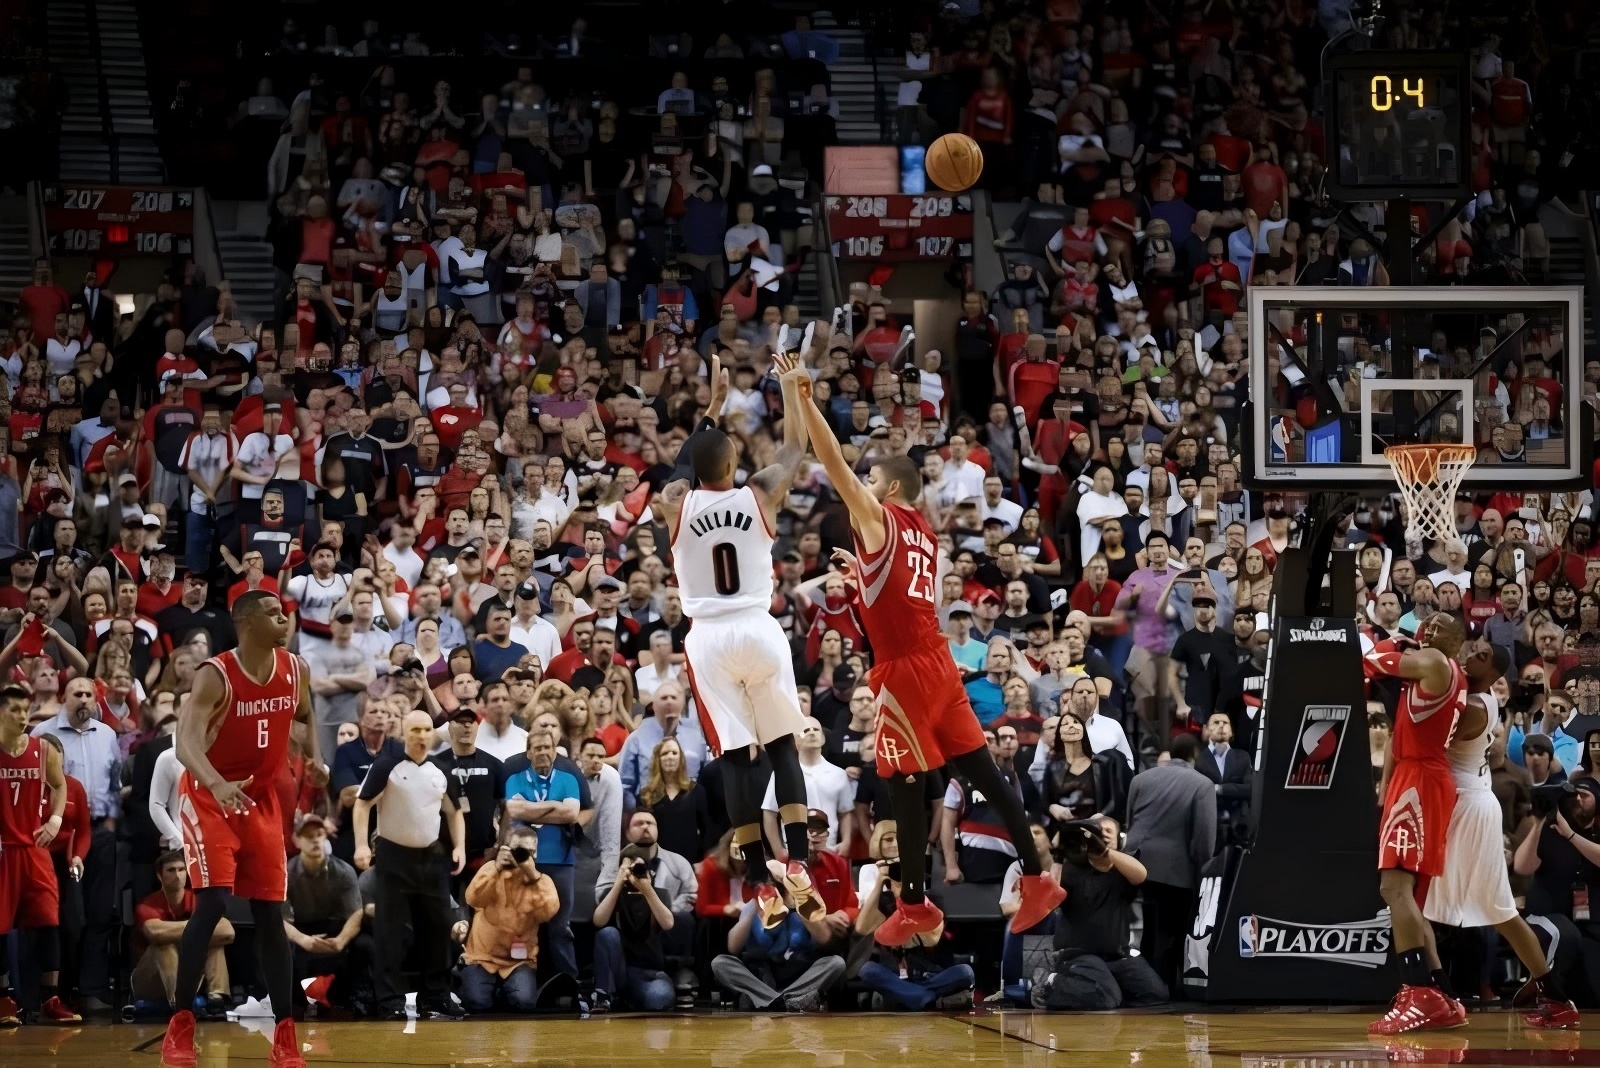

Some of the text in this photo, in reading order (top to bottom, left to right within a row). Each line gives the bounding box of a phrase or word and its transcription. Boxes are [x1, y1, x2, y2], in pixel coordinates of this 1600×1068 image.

[1371, 75, 1424, 111] 0.4
[63, 189, 106, 210] 207
[909, 197, 953, 218] 209
[136, 232, 176, 253] 106
[845, 236, 884, 257] 106
[916, 236, 954, 256] 107
[712, 542, 740, 596] 0
[907, 550, 935, 604] 25
[257, 718, 269, 749] 6
[10, 781, 21, 807] 7
[1258, 927, 1391, 953] PLAYOFFS
